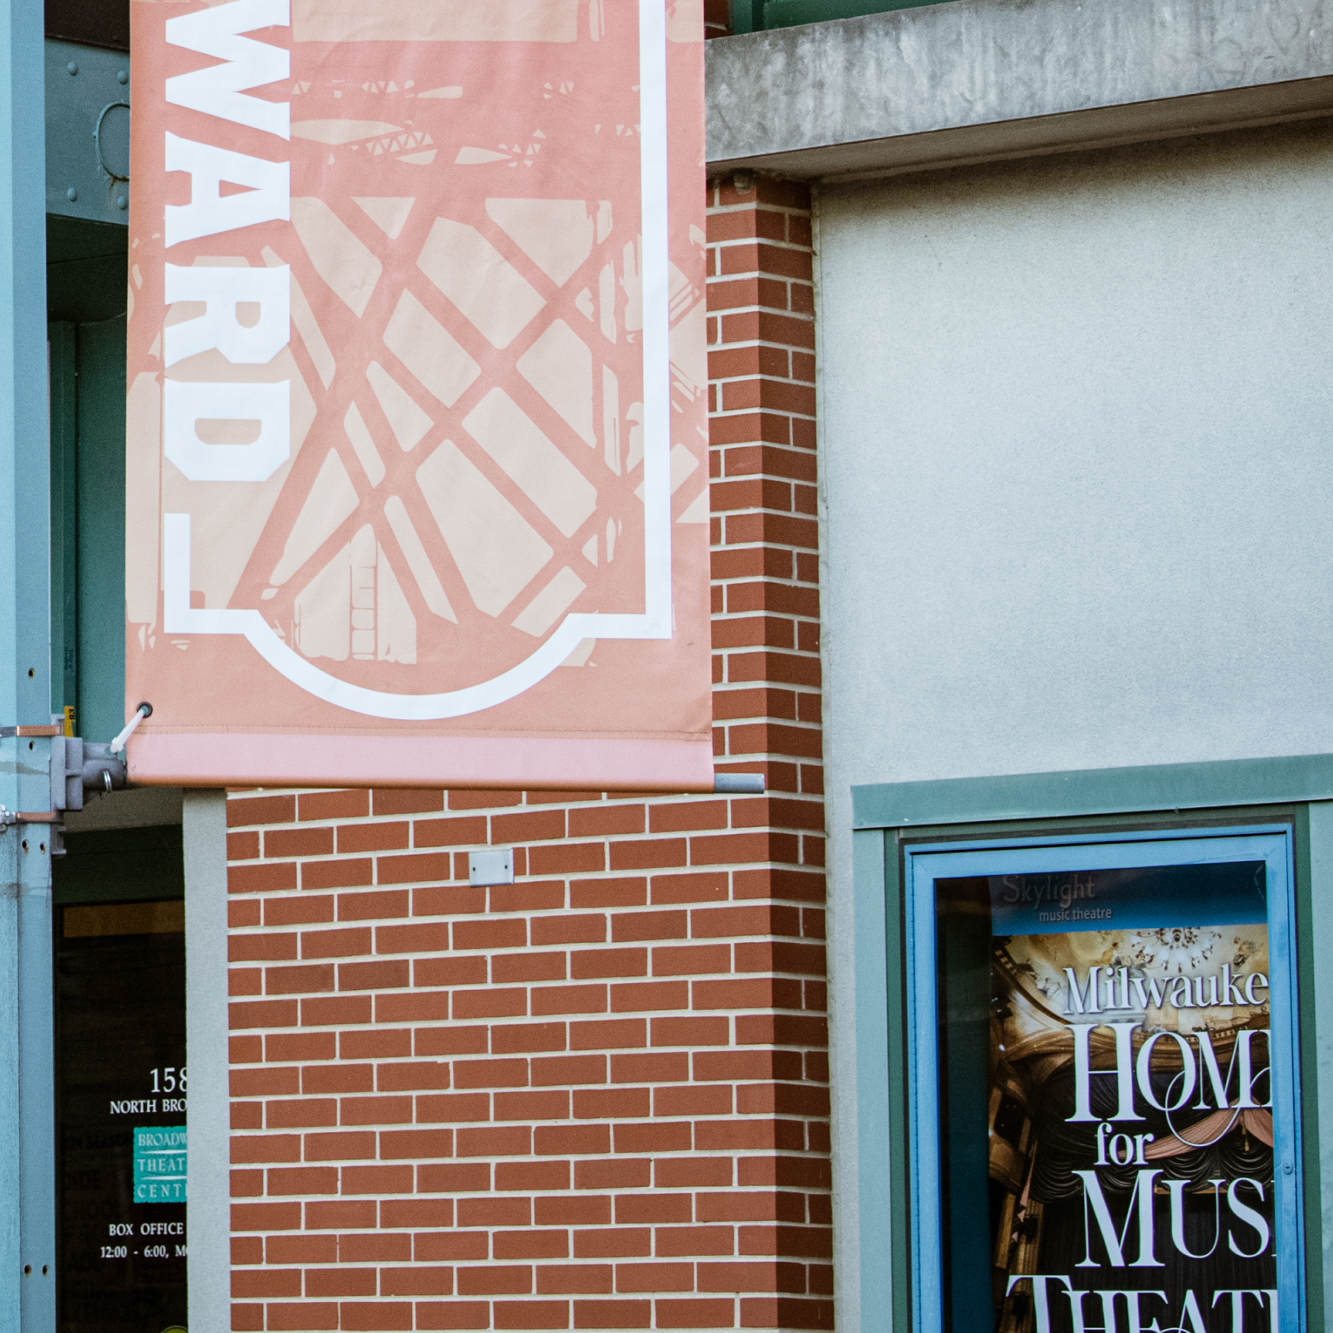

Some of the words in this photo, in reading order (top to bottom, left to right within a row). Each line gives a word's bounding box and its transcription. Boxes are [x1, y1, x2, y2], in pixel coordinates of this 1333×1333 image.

[1002, 873, 1095, 910] Skylight
[1039, 909, 1070, 922] music
[1073, 907, 1112, 920] theatre
[1064, 1023, 1273, 1147] HOM
[110, 1099, 157, 1114] NORTH
[1093, 1122, 1154, 1166] for
[137, 1183, 187, 1198] CENT
[1071, 1169, 1277, 1267] MUS
[108, 1223, 134, 1236] BOX
[140, 1222, 184, 1235] OFFICE
[100, 1246, 128, 1258] 12:00
[143, 1246, 169, 1259] 6:00,
